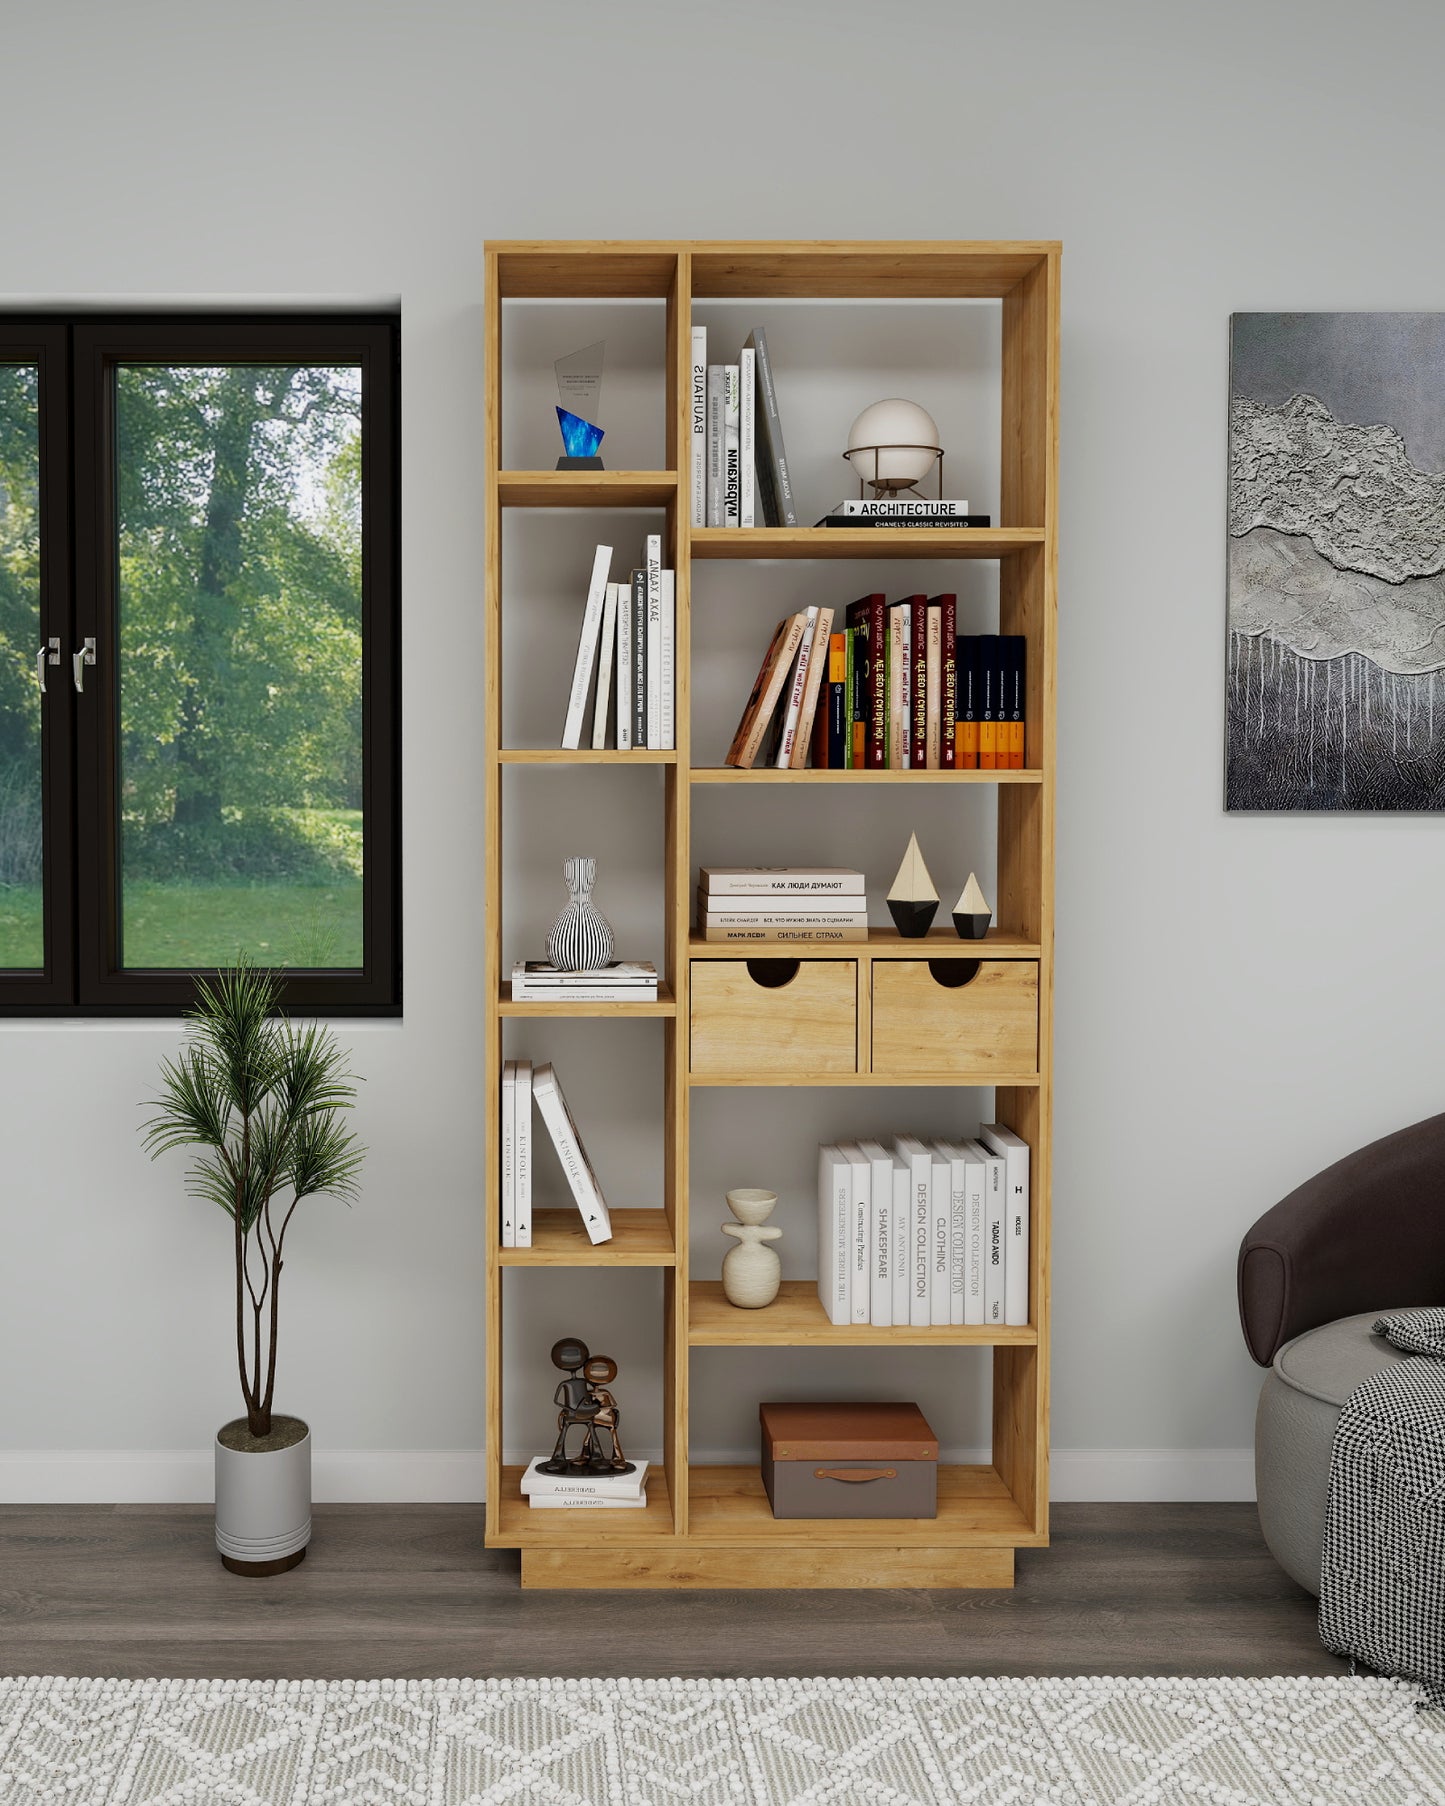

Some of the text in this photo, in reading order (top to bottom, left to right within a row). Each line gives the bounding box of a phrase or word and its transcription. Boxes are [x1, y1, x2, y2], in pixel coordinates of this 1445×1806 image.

[860, 503, 956, 515] ARCHITECTURE
[559, 1138, 580, 1178] KINFOLK
[838, 1188, 846, 1302] THE THREE MUSKETEERS
[856, 1202, 865, 1243] Constructing
[879, 1208, 888, 1279] SHAKESPEARE
[898, 1216, 905, 1231] MY
[916, 1183, 926, 1298] DESIGN COLLECTION
[936, 1217, 946, 1273] CLOTHING
[952, 1190, 963, 1295] DESIGN COLLECTION
[971, 1234, 979, 1297] COLLECTION
[991, 1245, 999, 1265] ANDO
